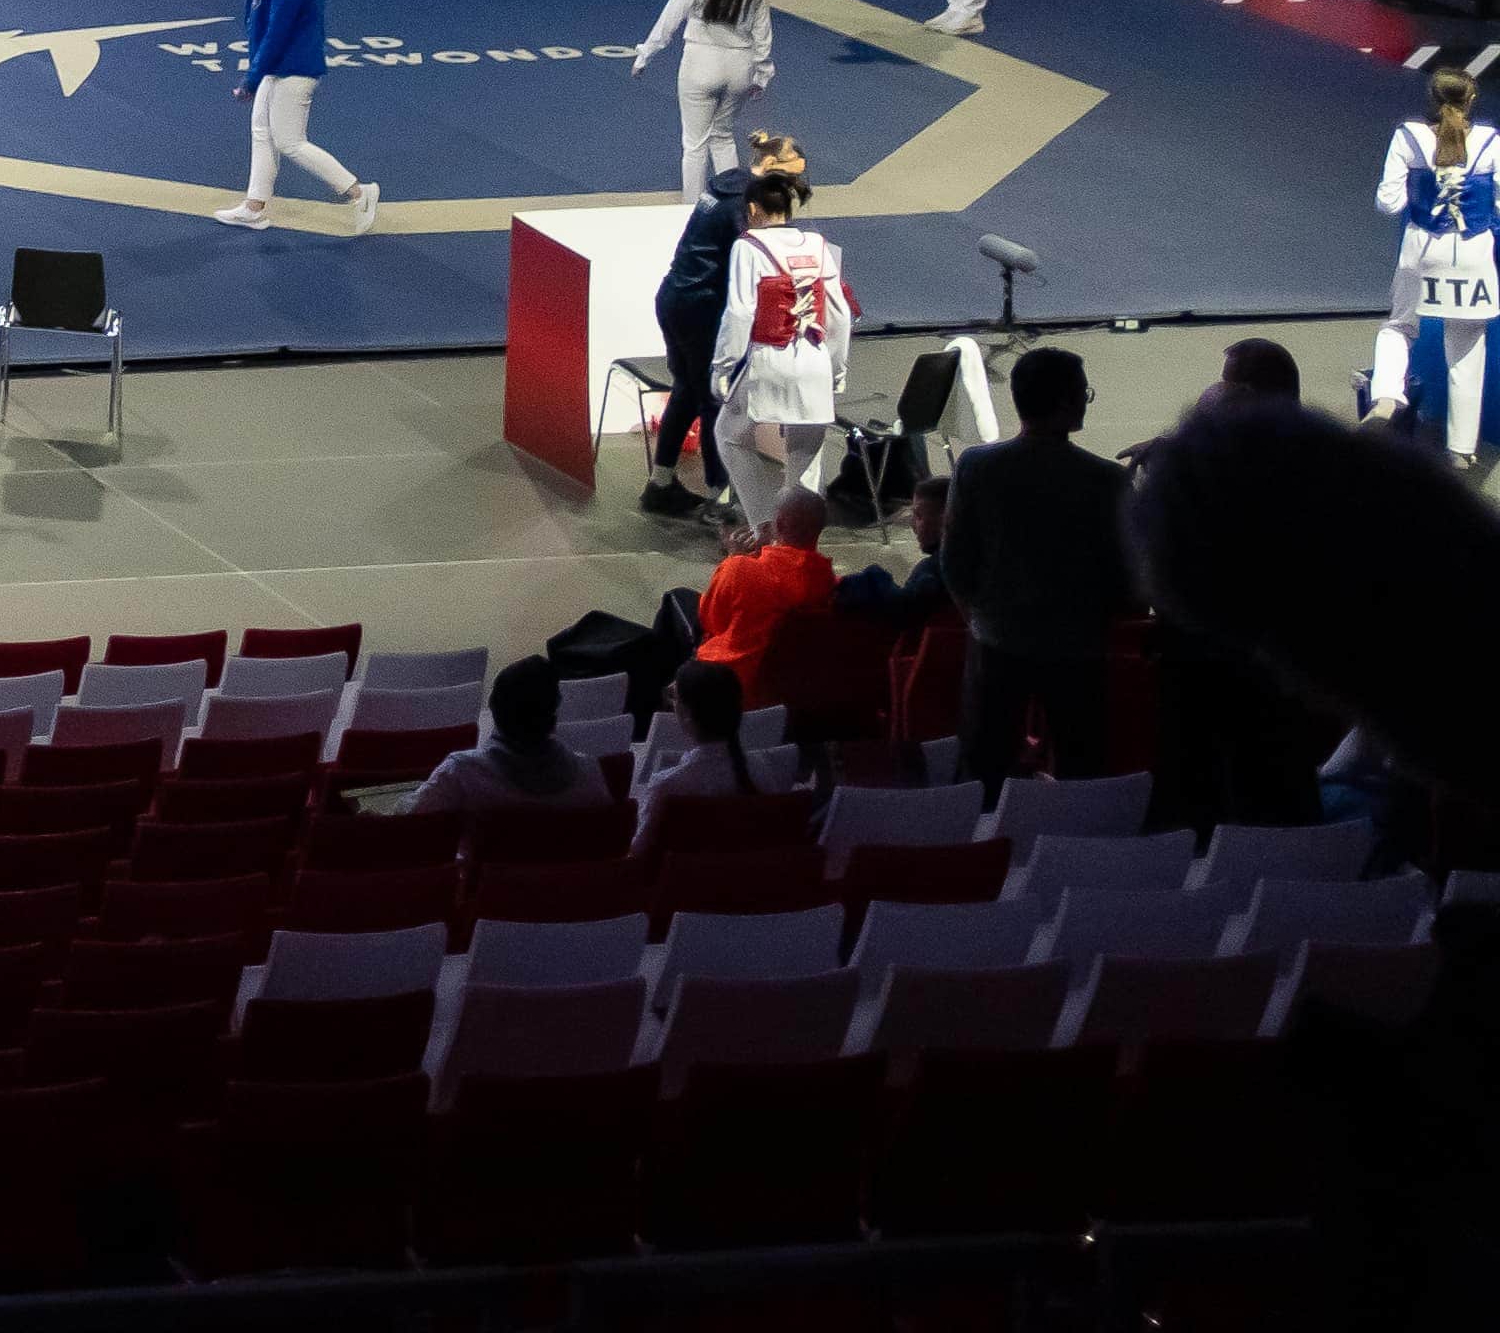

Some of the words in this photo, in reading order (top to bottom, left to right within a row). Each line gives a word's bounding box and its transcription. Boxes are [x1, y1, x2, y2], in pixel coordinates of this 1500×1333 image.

[157, 36, 404, 57] WLD
[190, 46, 641, 72] TKWONDO
[1422, 276, 1493, 308] ITA
